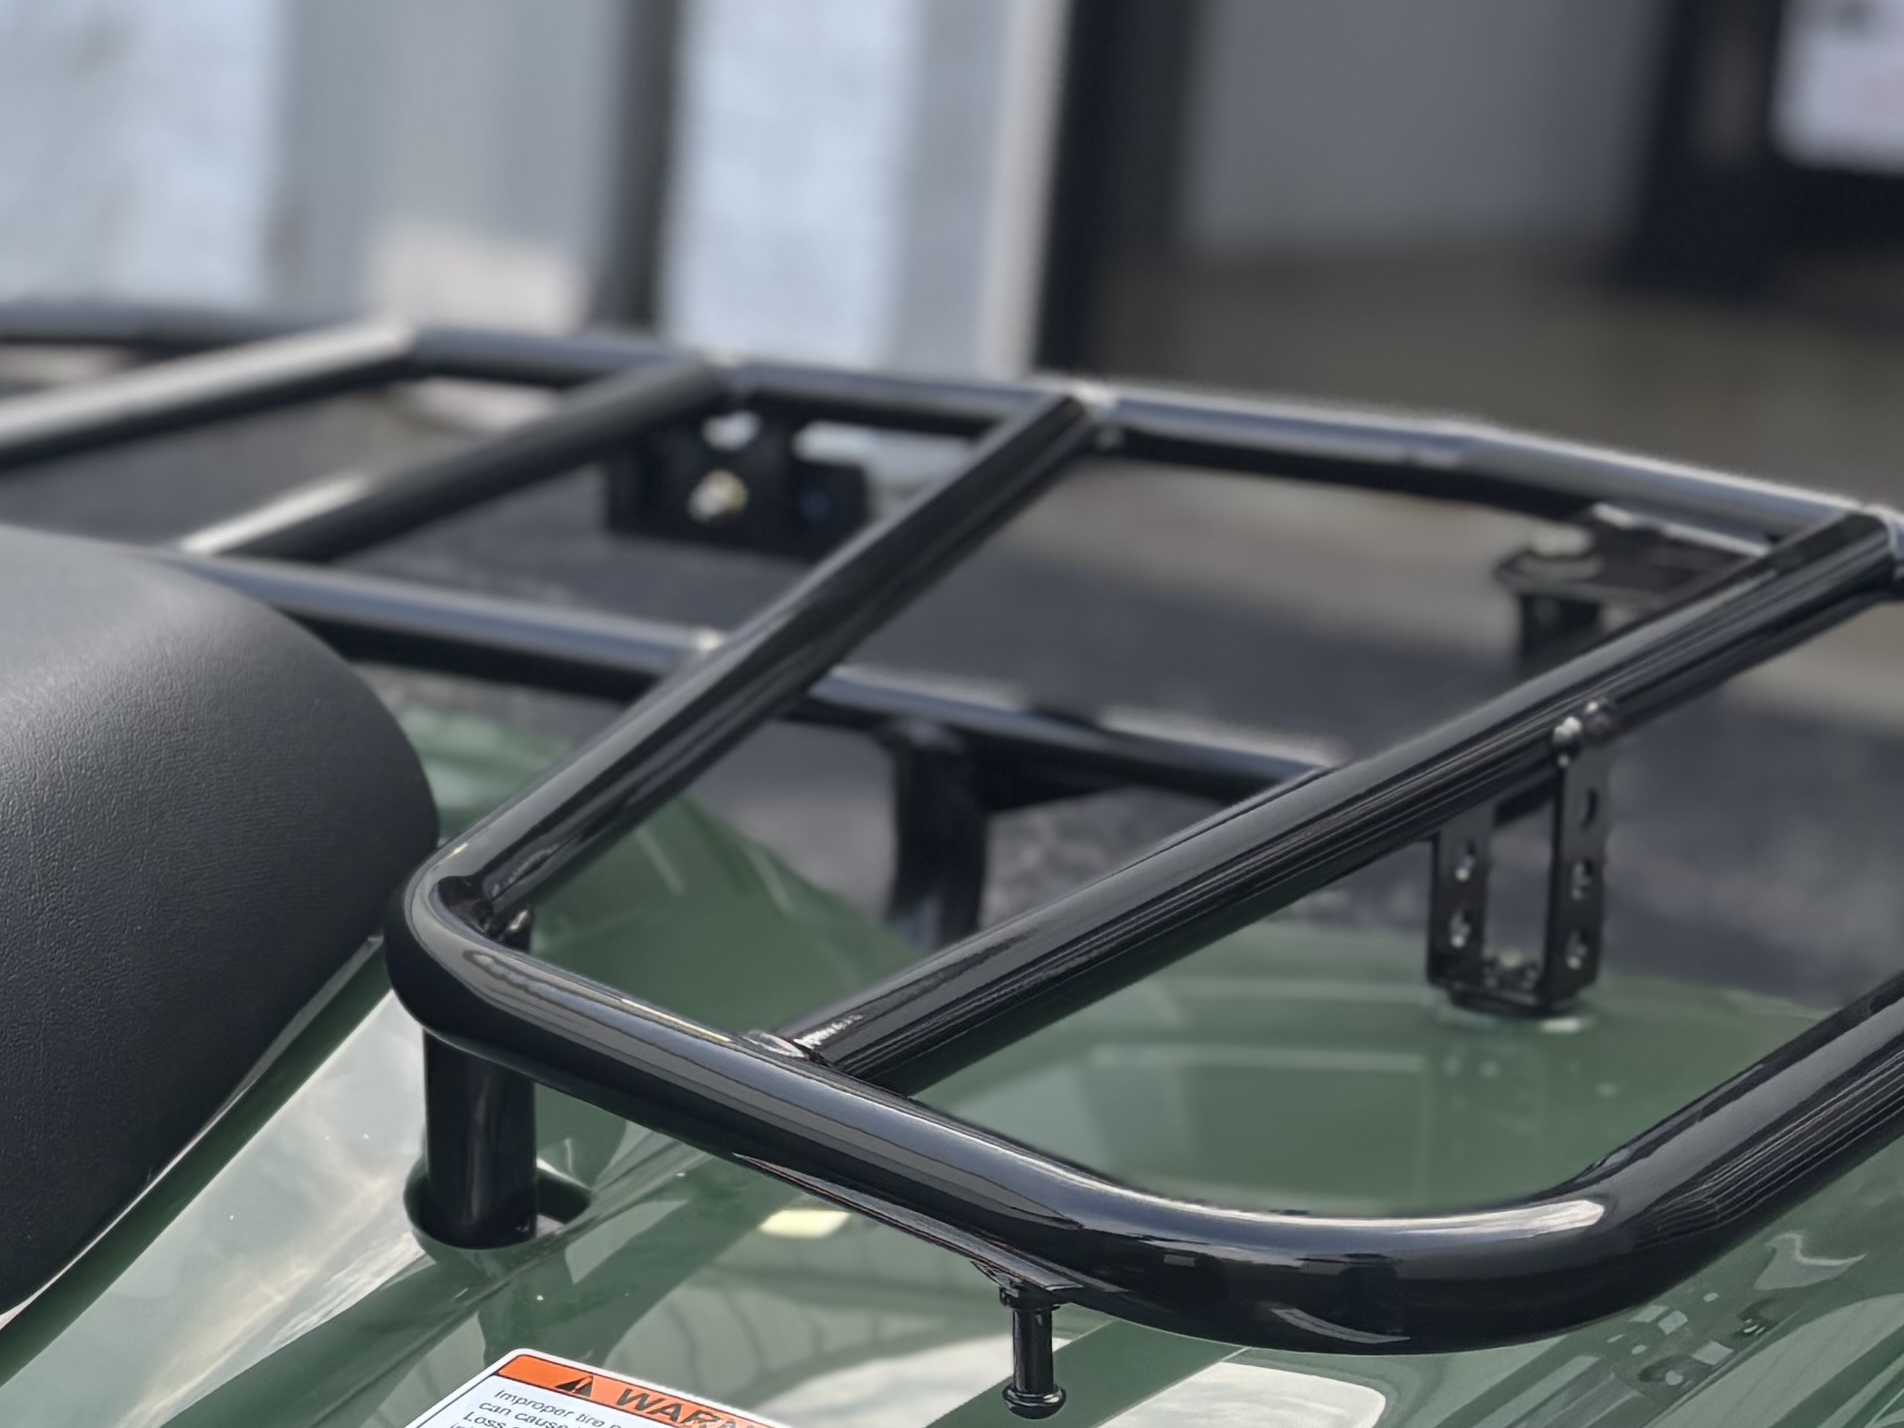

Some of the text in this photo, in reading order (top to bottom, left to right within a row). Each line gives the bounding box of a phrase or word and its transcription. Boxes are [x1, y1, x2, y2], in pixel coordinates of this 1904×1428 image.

[478, 1402, 512, 1416] can
[493, 1389, 575, 1418] Improper
[575, 1413, 606, 1428] tire
